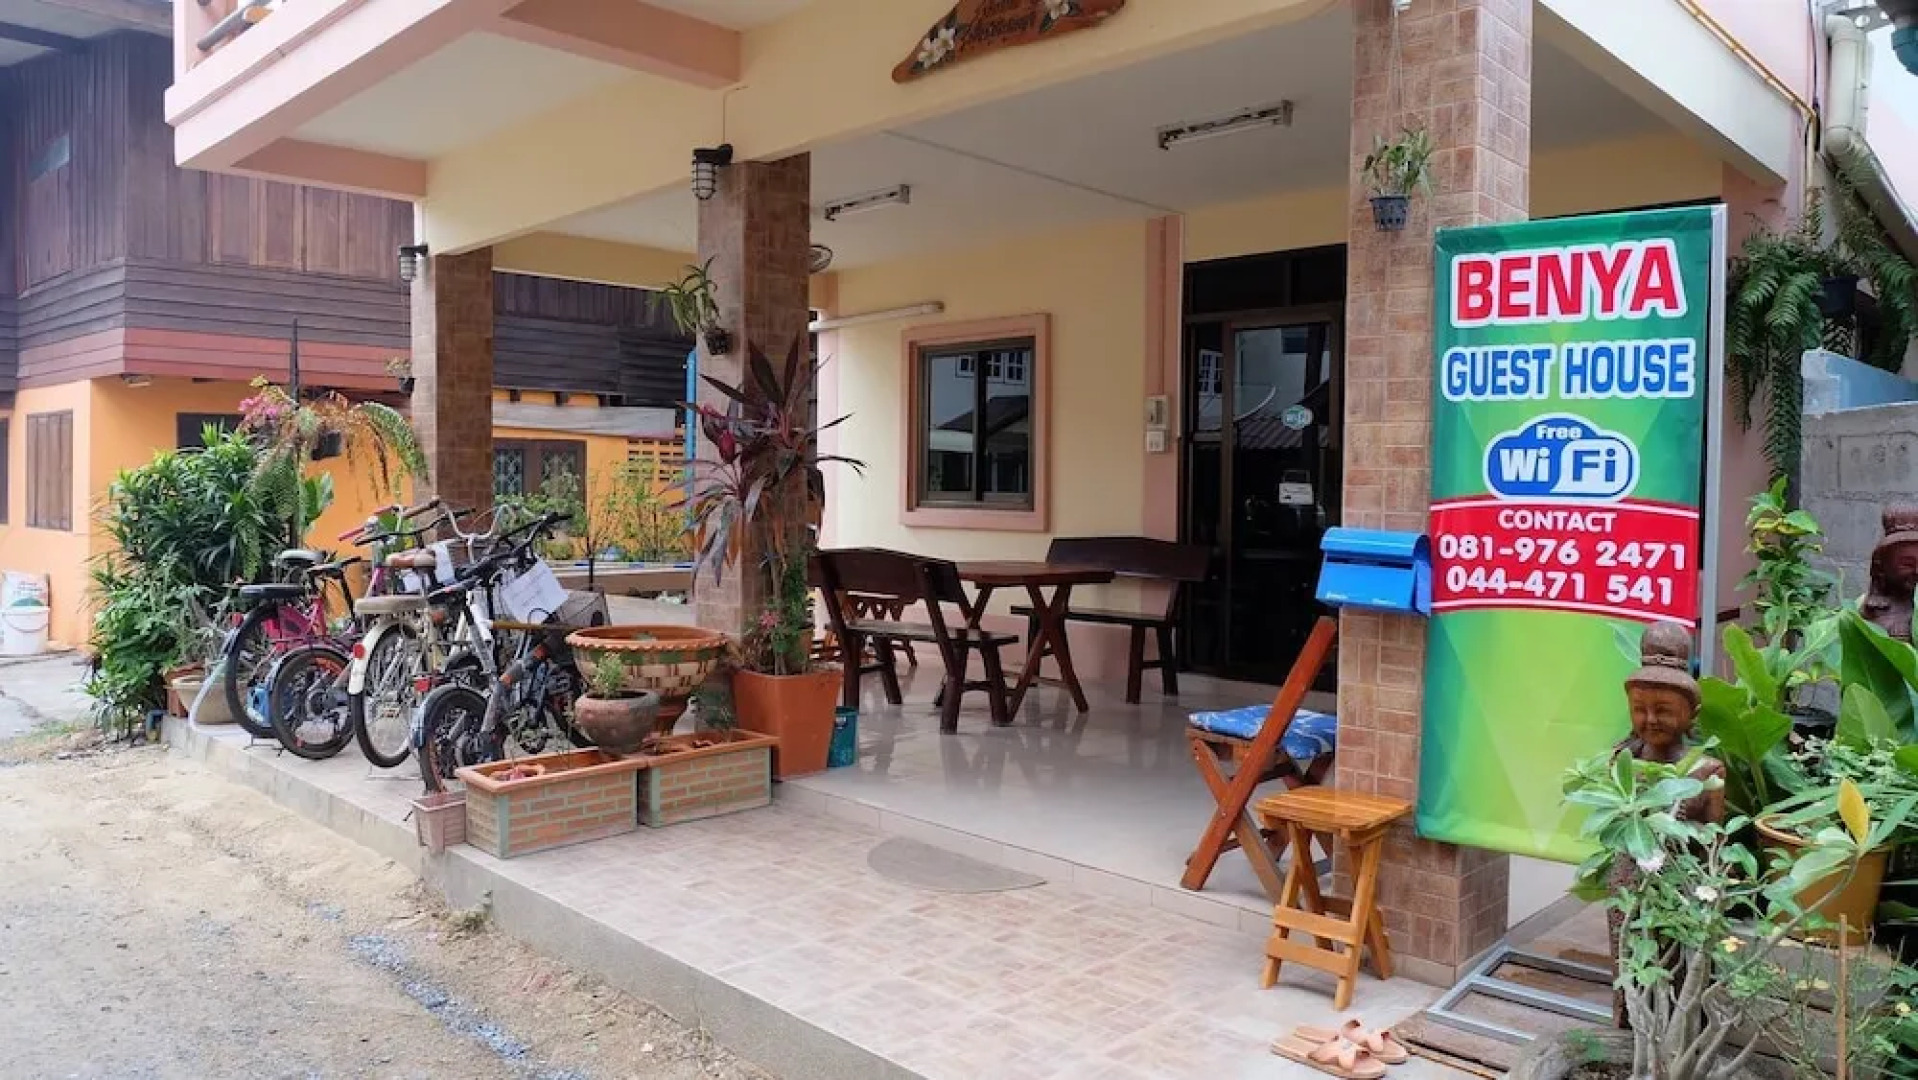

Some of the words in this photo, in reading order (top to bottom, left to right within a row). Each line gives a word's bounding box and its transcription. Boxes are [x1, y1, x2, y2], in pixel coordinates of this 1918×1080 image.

[1457, 246, 1679, 321] BENYA
[1447, 349, 1552, 396] GUEST
[1564, 344, 1689, 393] HOUSE
[1536, 424, 1582, 440] Free
[1498, 510, 1617, 532] CONTACT
[1439, 534, 1581, 566] 081-976
[1595, 540, 1686, 571] 2471
[1446, 566, 1586, 600] 044-471
[1606, 575, 1673, 606] 541
